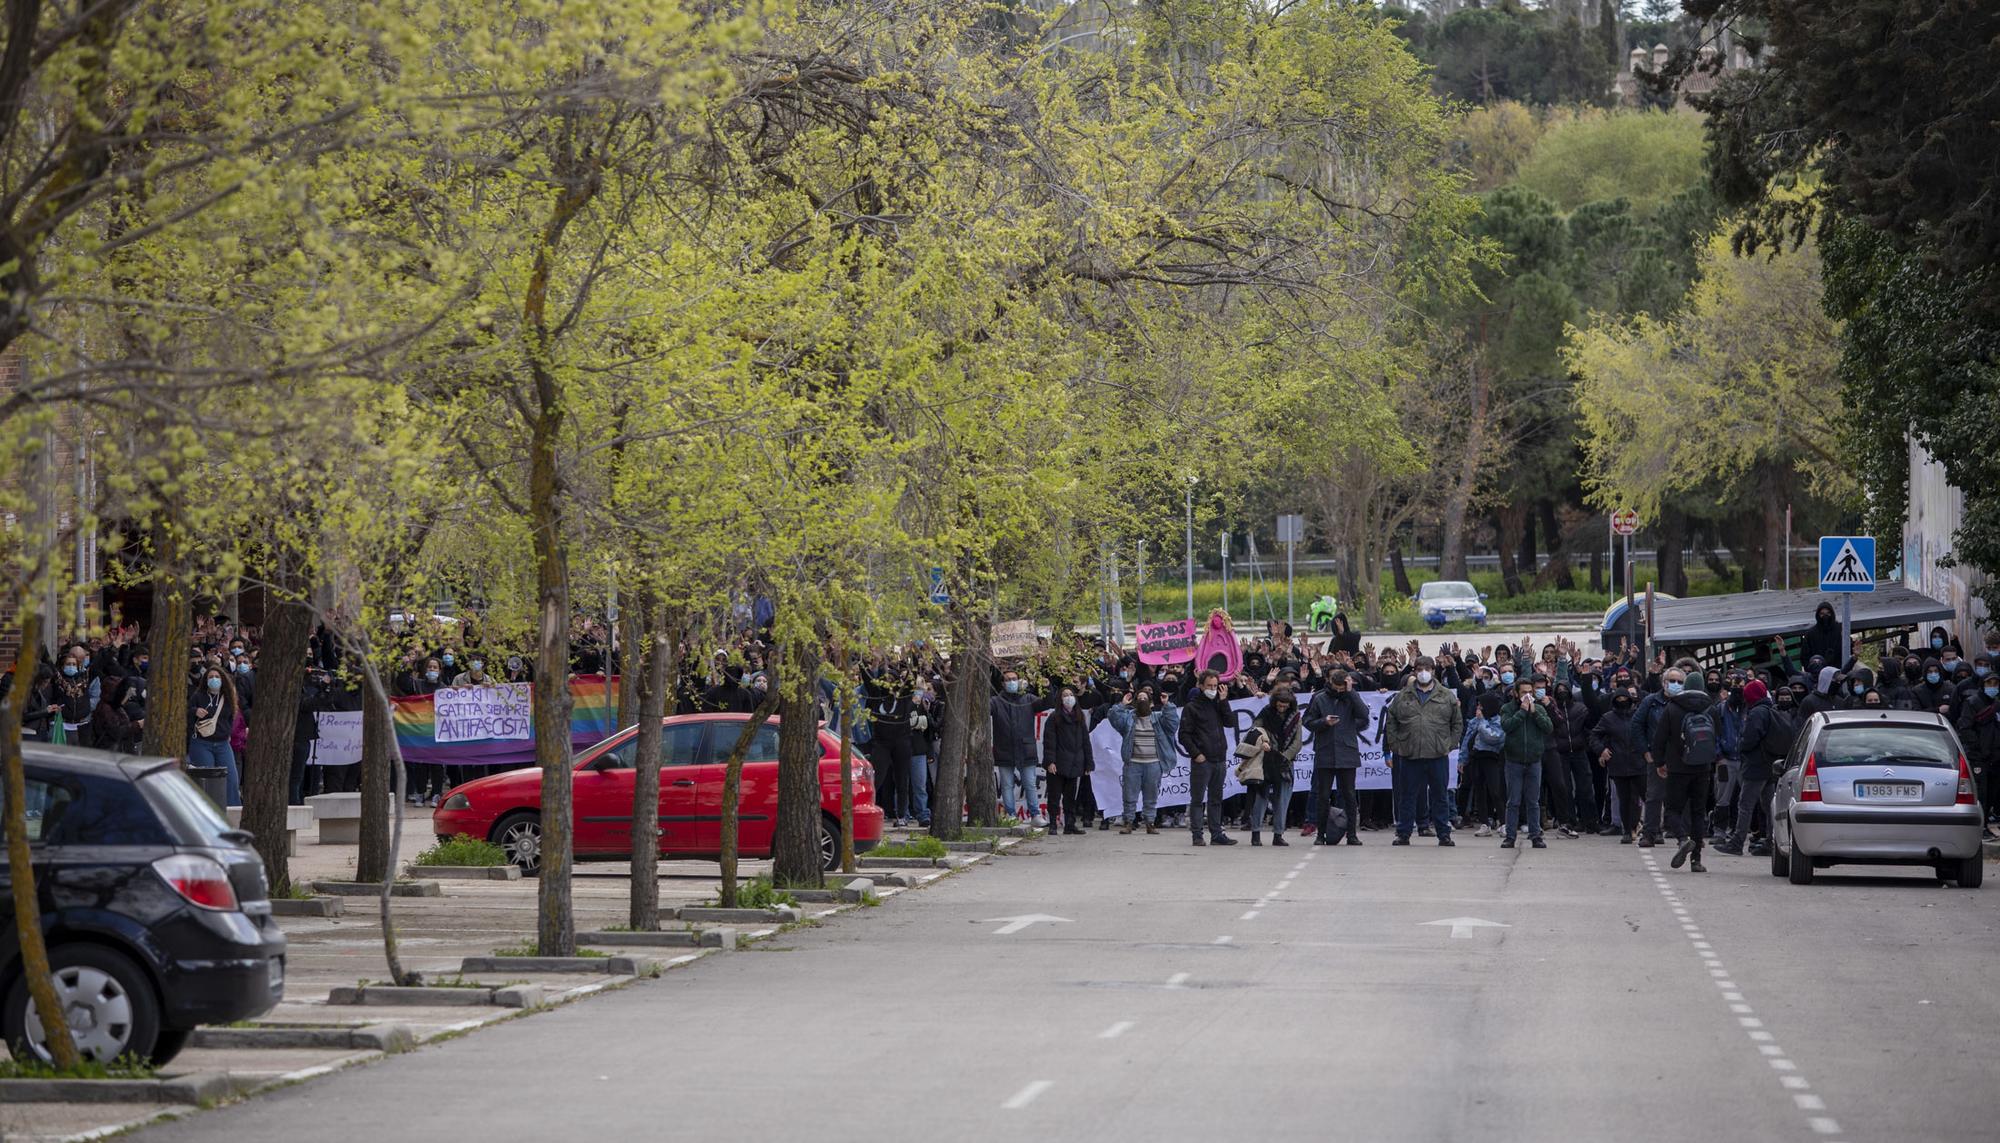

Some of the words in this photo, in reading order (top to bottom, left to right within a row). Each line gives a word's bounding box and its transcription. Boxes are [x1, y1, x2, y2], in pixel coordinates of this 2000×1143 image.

[1141, 622, 1186, 639] VAMOS
[438, 690, 467, 700] COMO
[438, 703, 483, 717] GATITA
[438, 717, 529, 739] ANTIFASCISTA
[1866, 786, 1893, 796] 1963
[1896, 786, 1917, 796] FMS
